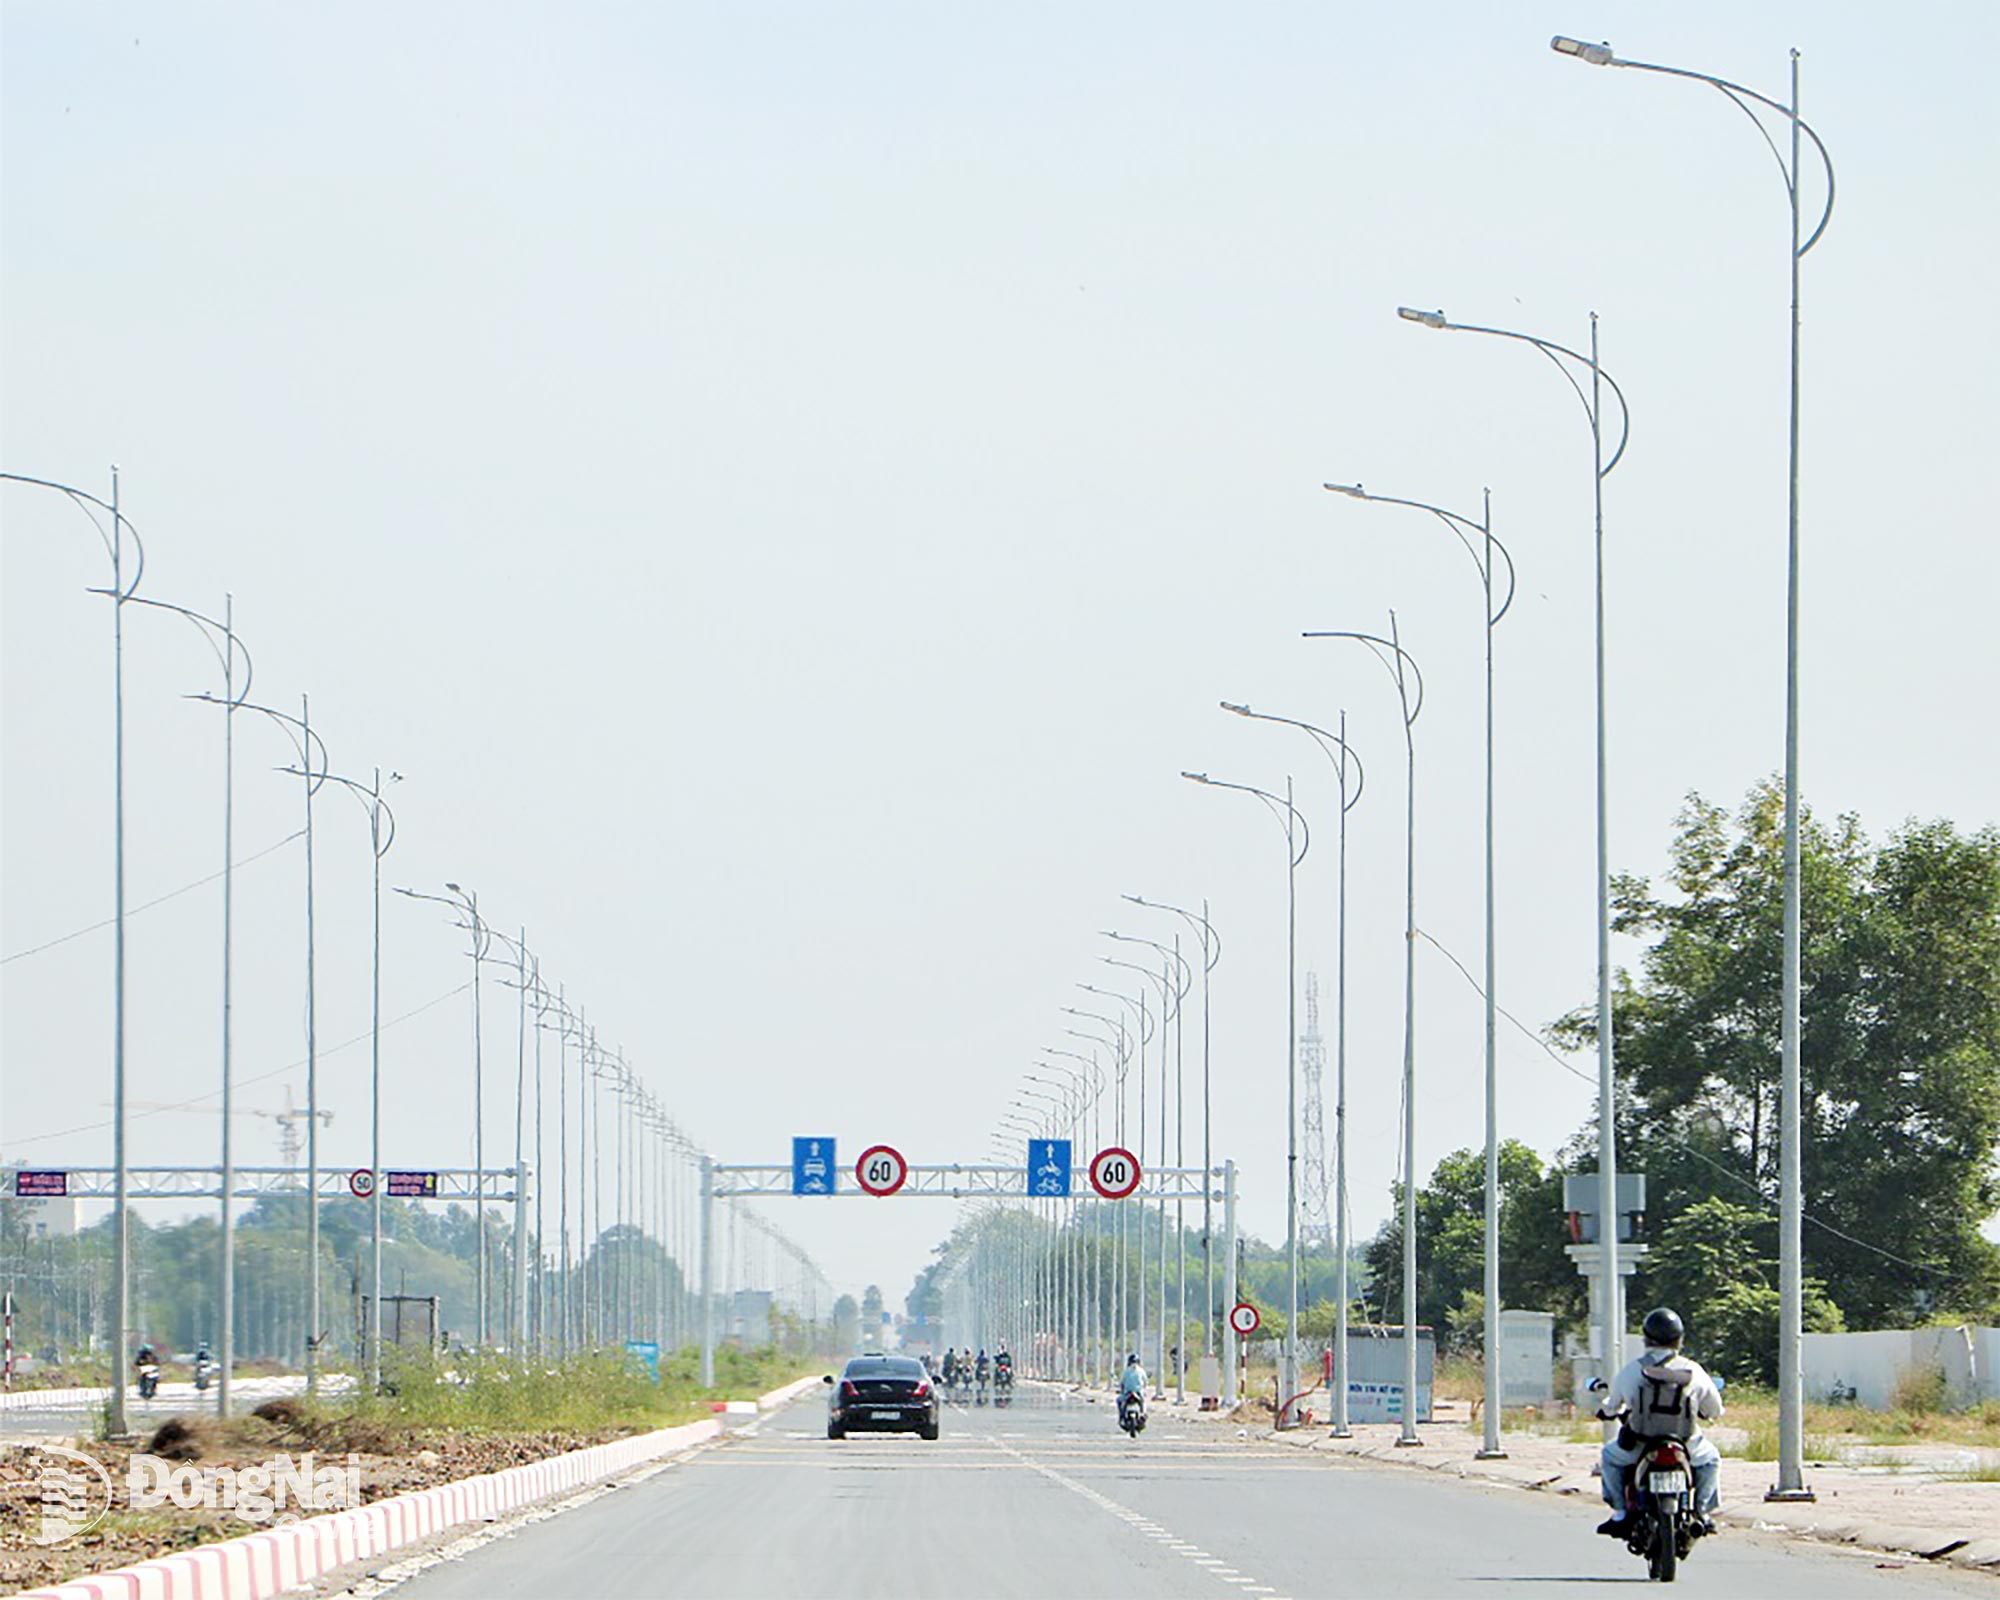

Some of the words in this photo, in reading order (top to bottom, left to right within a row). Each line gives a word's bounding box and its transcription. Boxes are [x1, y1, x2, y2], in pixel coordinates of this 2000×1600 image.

[869, 1160, 891, 1182] 60
[1103, 1161, 1125, 1184] 60
[356, 1176, 371, 1190] 50
